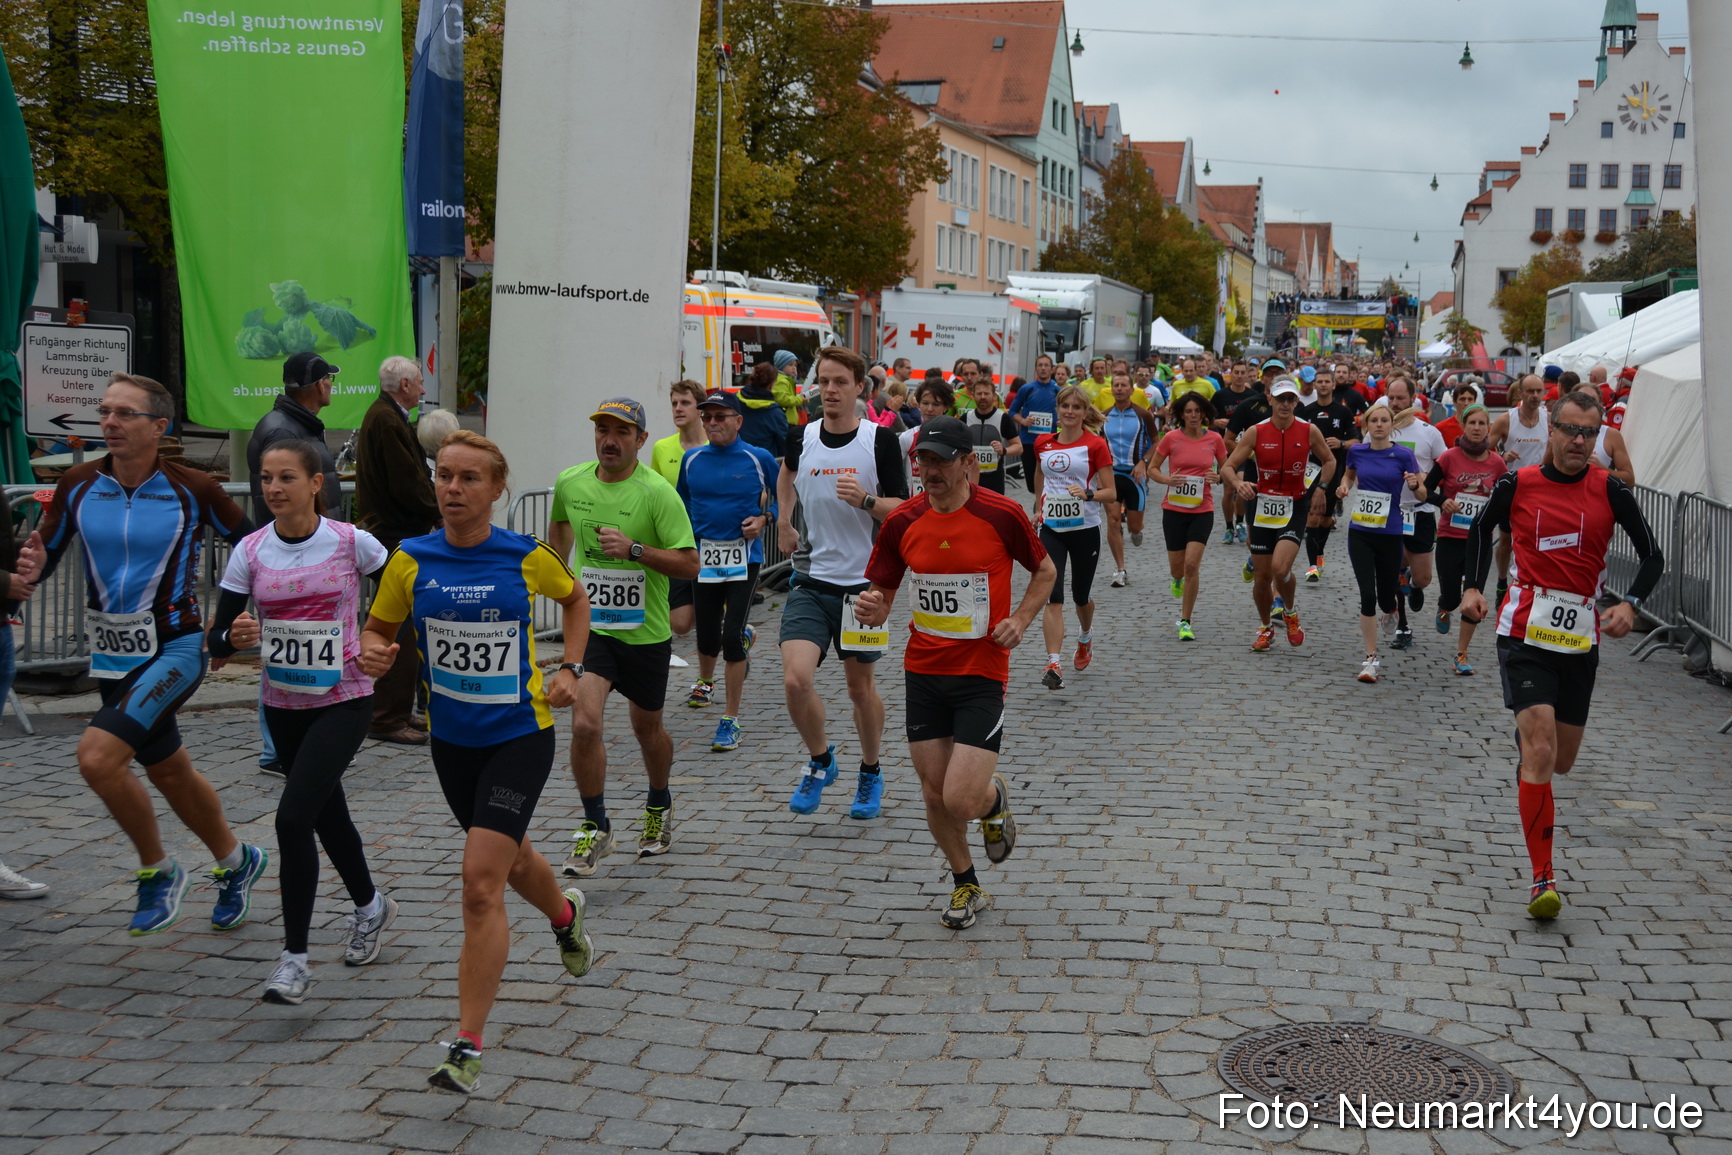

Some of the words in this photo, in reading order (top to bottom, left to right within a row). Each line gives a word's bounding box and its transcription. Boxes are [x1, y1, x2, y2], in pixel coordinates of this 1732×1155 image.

[44, 244, 57, 254] Hut
[59, 244, 65, 254] &
[66, 244, 85, 254] Mode
[495, 281, 649, 303] www.bmw-laufsport.de
[1325, 318, 1356, 326] START
[936, 324, 977, 334] Bayerisches
[935, 332, 955, 341] Rotes
[29, 336, 82, 348] Fußgänger
[84, 338, 126, 351] Richtung
[935, 341, 955, 349] Kreuz
[46, 350, 110, 364] Lammsbräu-
[42, 365, 89, 378] Kreuzung
[91, 366, 113, 378] über
[62, 380, 95, 391] Untere
[47, 394, 103, 406] Kaserngass
[600, 402, 632, 413] BOMAG
[1047, 502, 1081, 518] 2003
[1263, 502, 1285, 516] 503
[1360, 499, 1382, 514] 362
[1549, 538, 1568, 546] DEHN
[704, 549, 742, 566] 2379
[582, 572, 602, 581] PARTL
[602, 574, 635, 583] Neumarkt
[450, 585, 495, 593] INTERSPORT
[586, 582, 640, 607] 2586
[451, 592, 488, 600] LANGE
[918, 588, 959, 614] 505
[600, 611, 622, 623] Sepp
[1550, 605, 1578, 631] 98
[264, 625, 287, 635] PARTL
[289, 628, 328, 636] Neumarkt
[428, 625, 457, 638] PARTL
[459, 630, 504, 638] Neumarkt
[95, 626, 152, 653] 3058
[859, 634, 880, 643] Marco
[1535, 629, 1582, 647] Hans-Peter
[269, 637, 336, 666] 2014
[436, 639, 511, 673] 2337
[285, 672, 317, 684] Nikola
[460, 679, 482, 692] Eva
